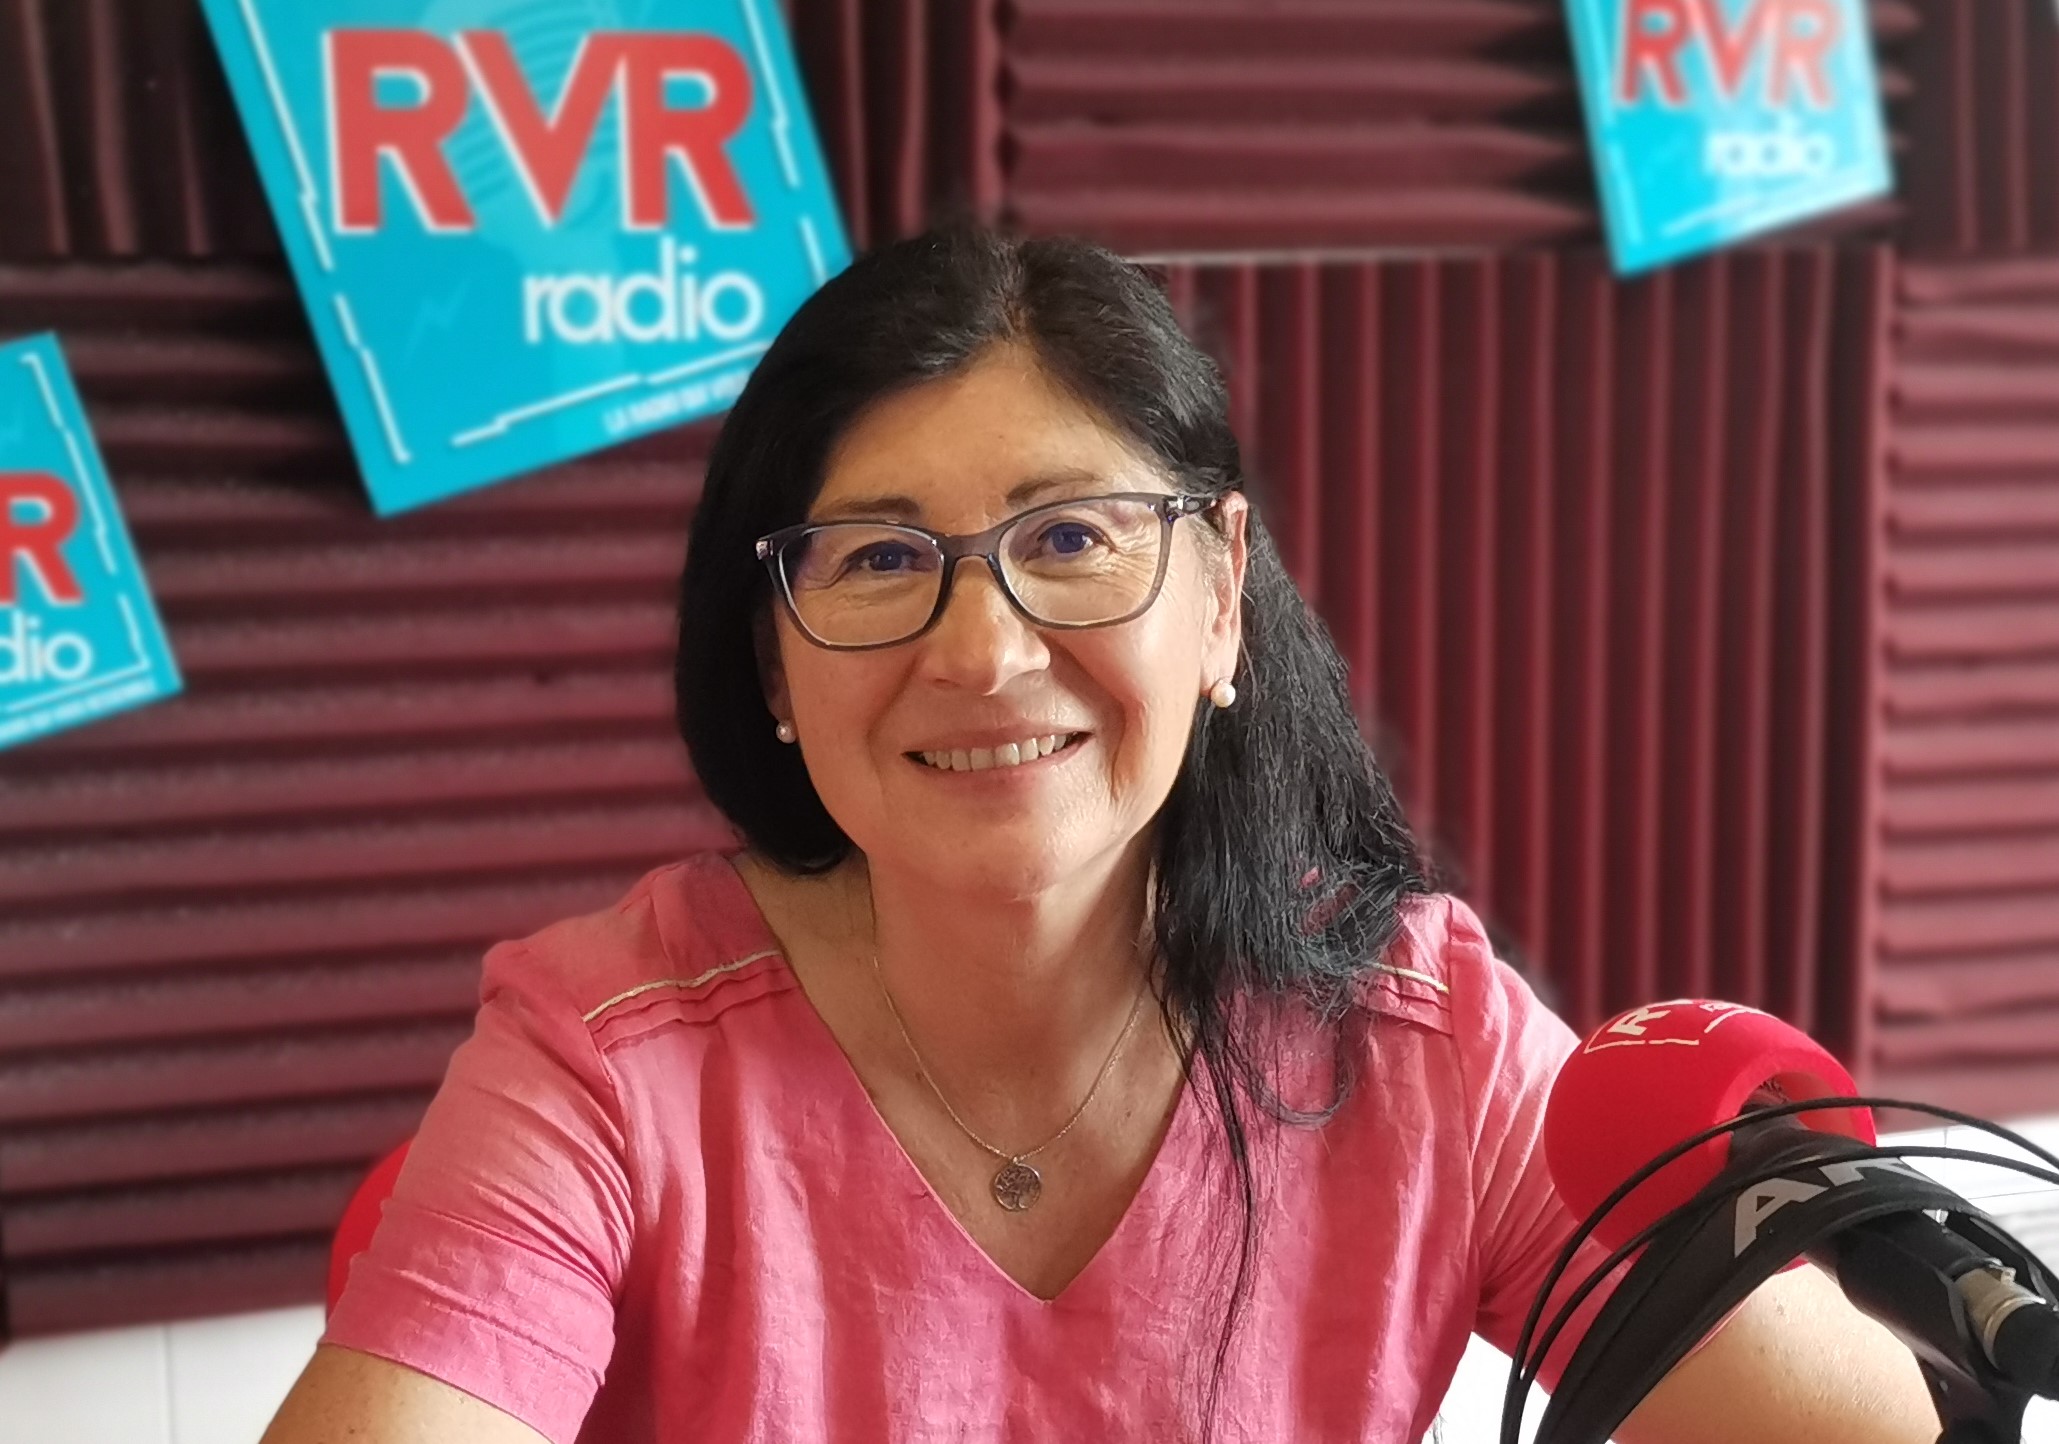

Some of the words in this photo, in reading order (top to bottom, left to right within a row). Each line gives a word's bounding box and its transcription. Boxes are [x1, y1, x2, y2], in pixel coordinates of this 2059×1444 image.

[1613, 0, 1844, 109] RVR
[322, 27, 759, 234] RVR
[522, 236, 763, 344] radio
